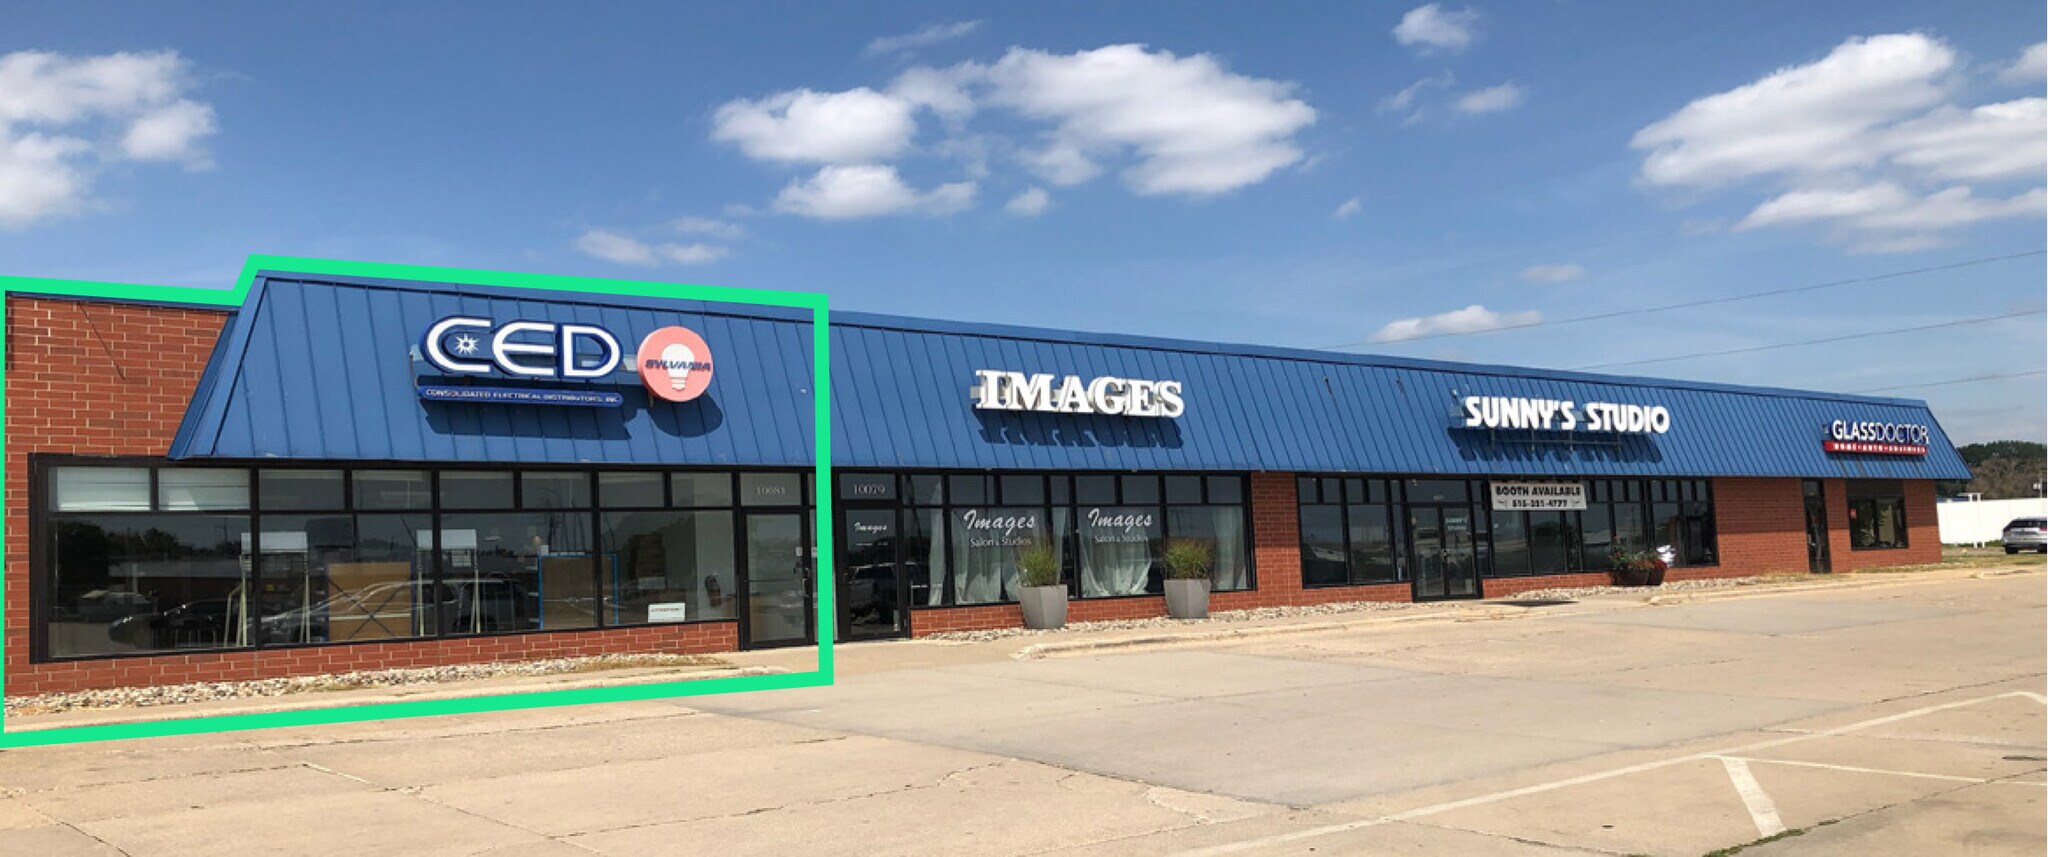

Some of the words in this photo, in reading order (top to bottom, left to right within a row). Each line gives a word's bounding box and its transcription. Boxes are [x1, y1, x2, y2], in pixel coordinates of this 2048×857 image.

[423, 316, 623, 378] CED
[645, 359, 711, 371] SYLVANIA
[976, 370, 1184, 417] IMAGES
[1465, 396, 1576, 431] SUNNY'S
[1585, 402, 1671, 434] STUDIO
[854, 484, 886, 495] 10079
[1496, 486, 1529, 496] BOOTH
[1532, 486, 1581, 497] AVAILABLE
[855, 522, 887, 534] Images
[963, 509, 1035, 536] Images
[1088, 507, 1152, 533] Images
[971, 537, 994, 547] Salon
[1001, 536, 1033, 546] Studios
